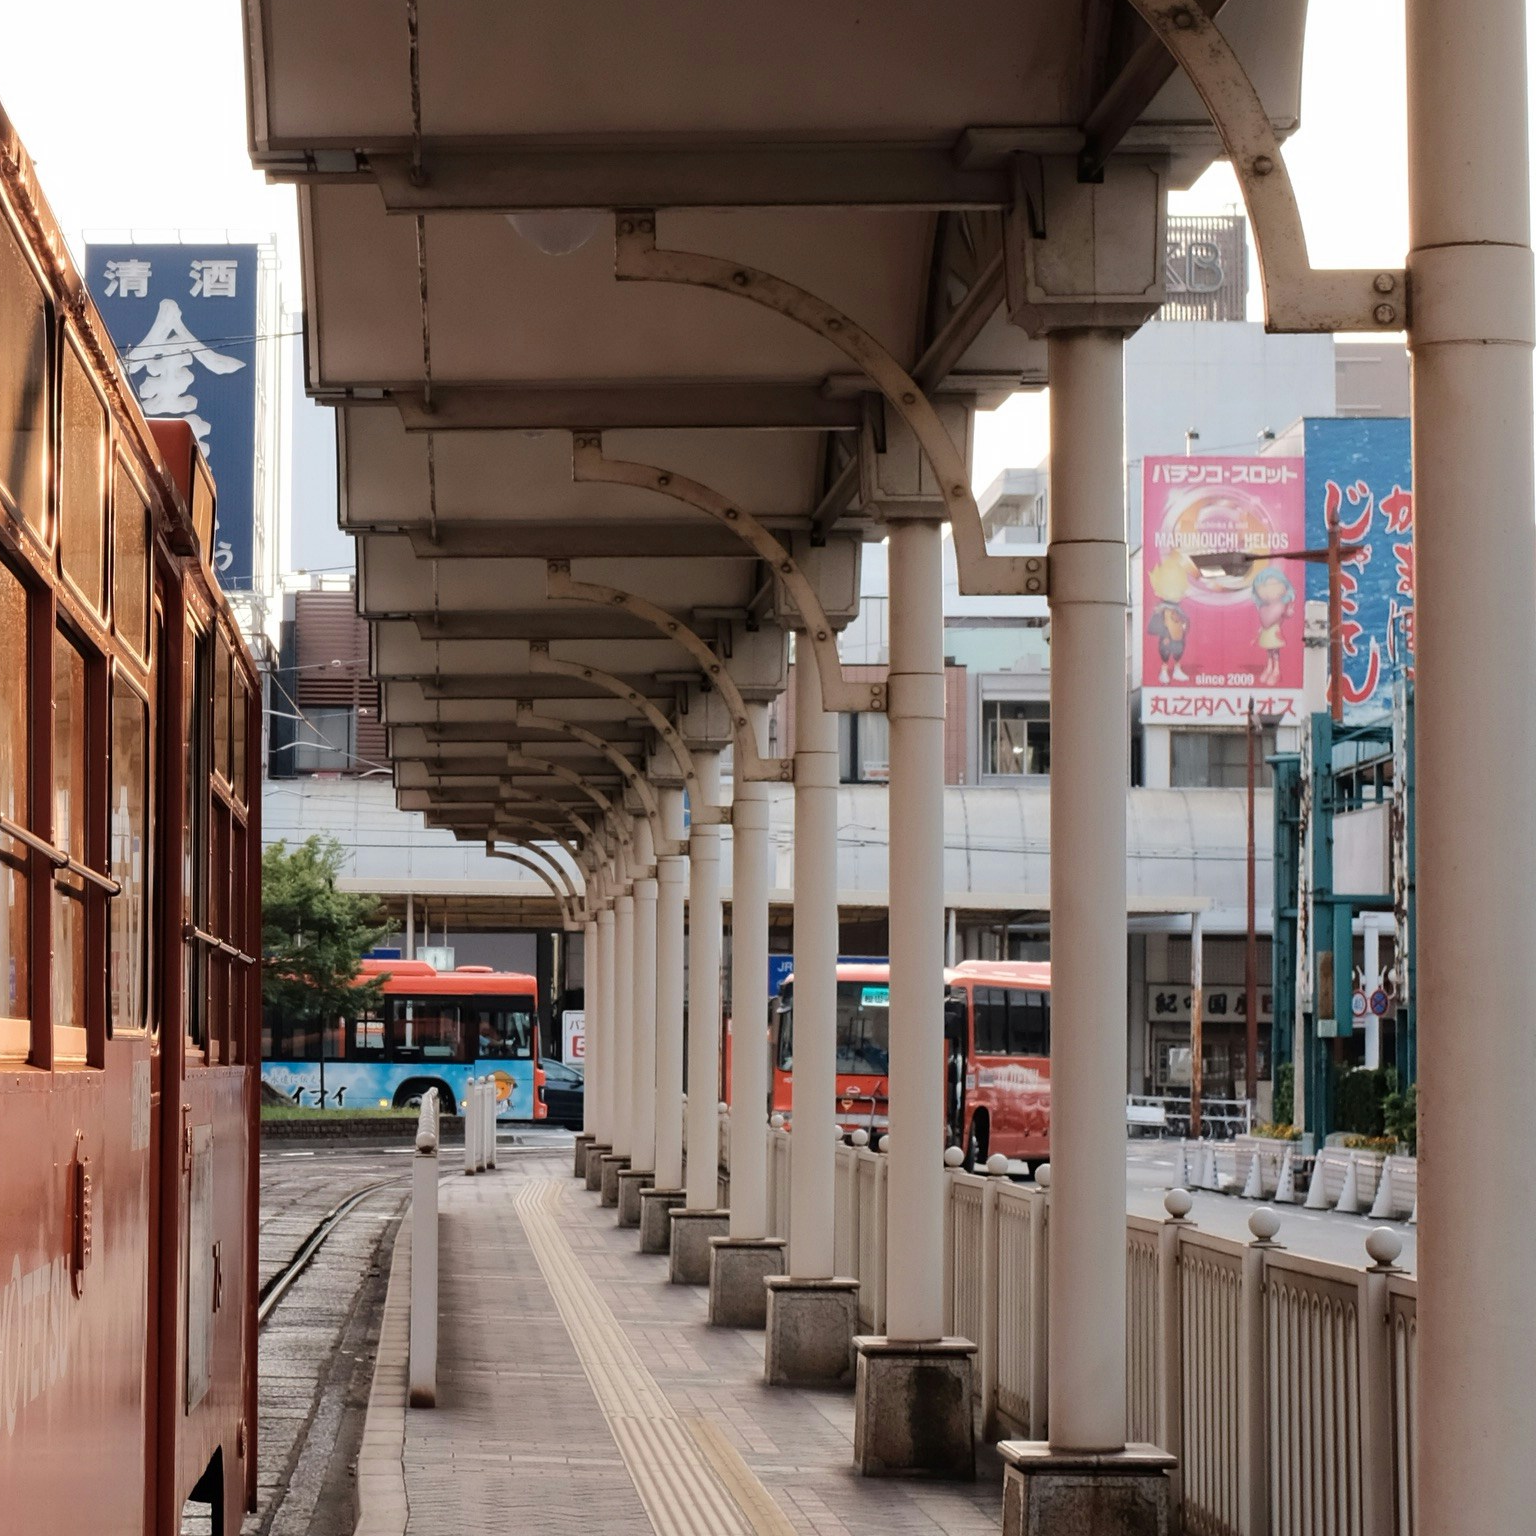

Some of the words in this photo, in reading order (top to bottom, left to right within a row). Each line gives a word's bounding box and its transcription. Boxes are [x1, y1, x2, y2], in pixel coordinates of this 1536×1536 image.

[104, 260, 238, 298] 清酒
[1152, 465, 1298, 484] パチンコ・スロット
[1155, 532, 1238, 549] MARUNOUCHI
[1244, 533, 1289, 550] HELIOS
[1195, 673, 1224, 685] since
[1227, 673, 1254, 686] 2009
[1150, 695, 1297, 716] 丸之内ヘリオス
